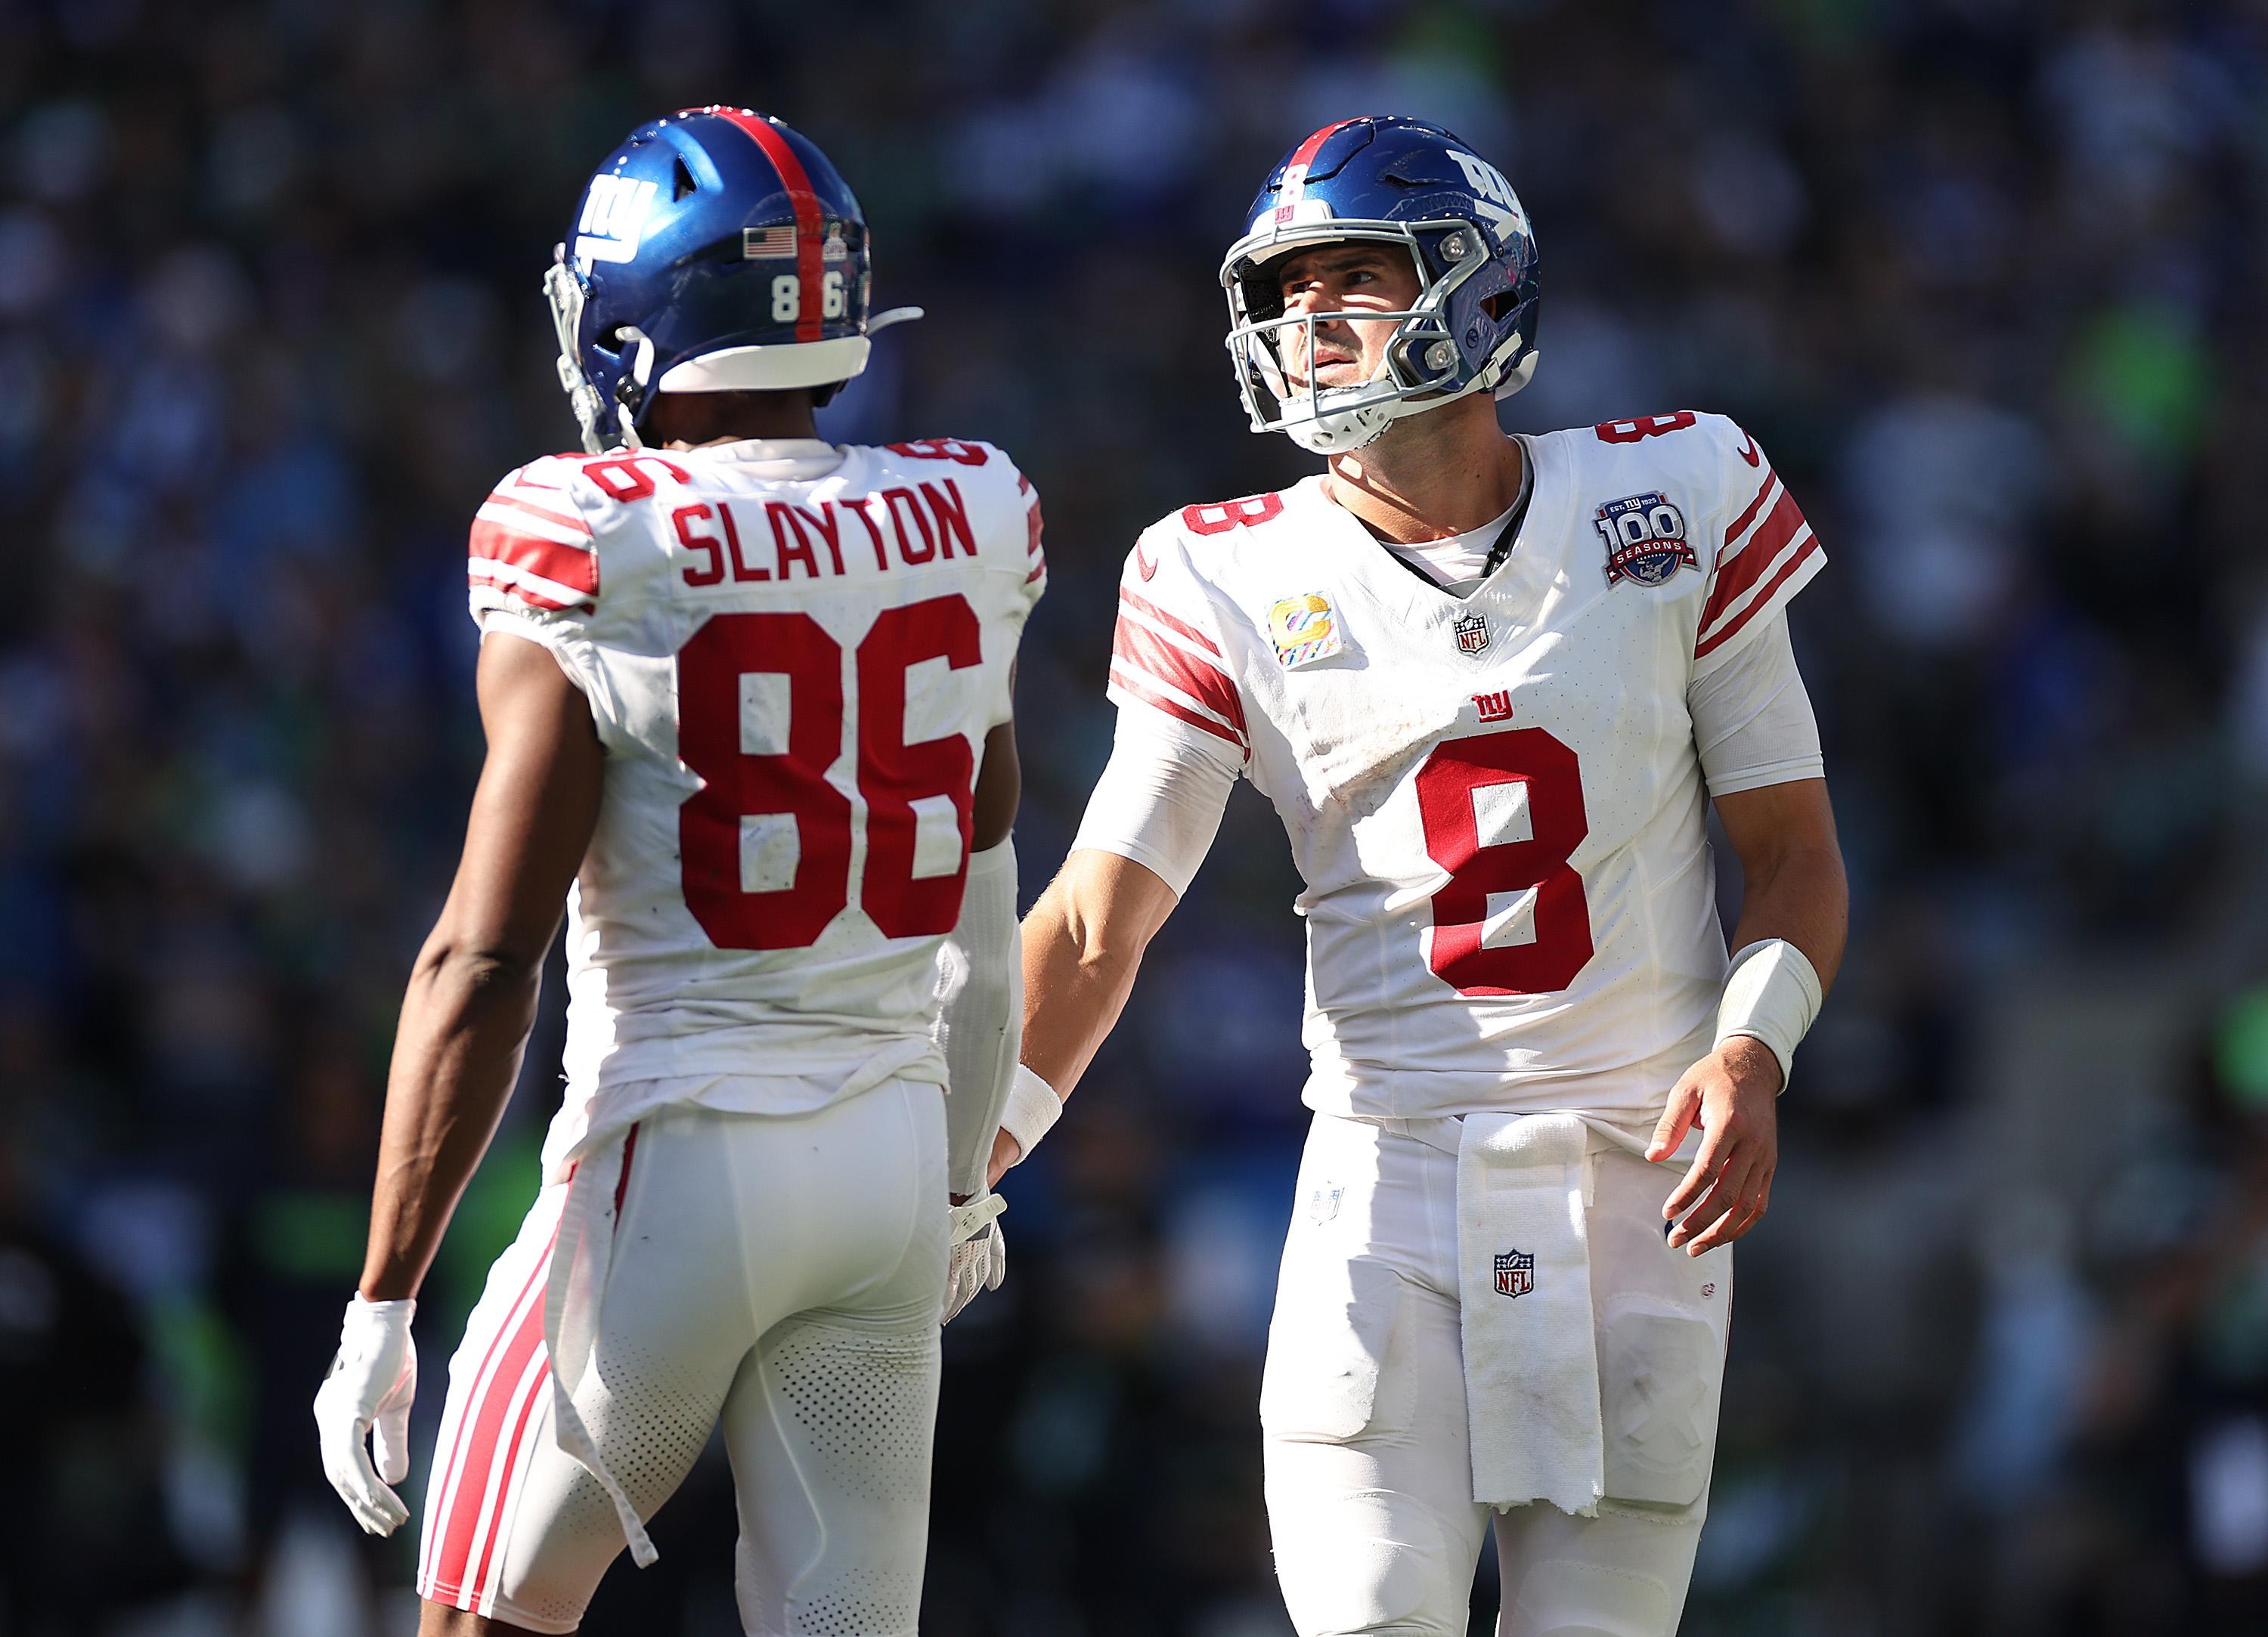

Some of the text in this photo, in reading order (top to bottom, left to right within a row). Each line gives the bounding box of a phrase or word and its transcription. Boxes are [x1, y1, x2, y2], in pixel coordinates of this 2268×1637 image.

[1594, 411, 1696, 444] 8
[1181, 492, 1284, 536] 8
[1641, 497, 1657, 506] 1925
[672, 478, 978, 587] SLAYTON
[1597, 505, 1684, 555] 100
[1616, 541, 1681, 564] SEASONS
[1272, 595, 1331, 649] C
[1459, 630, 1486, 649] NFL
[677, 593, 983, 951] 86
[1414, 726, 1595, 996] 8
[1498, 1271, 1530, 1294] NFL
